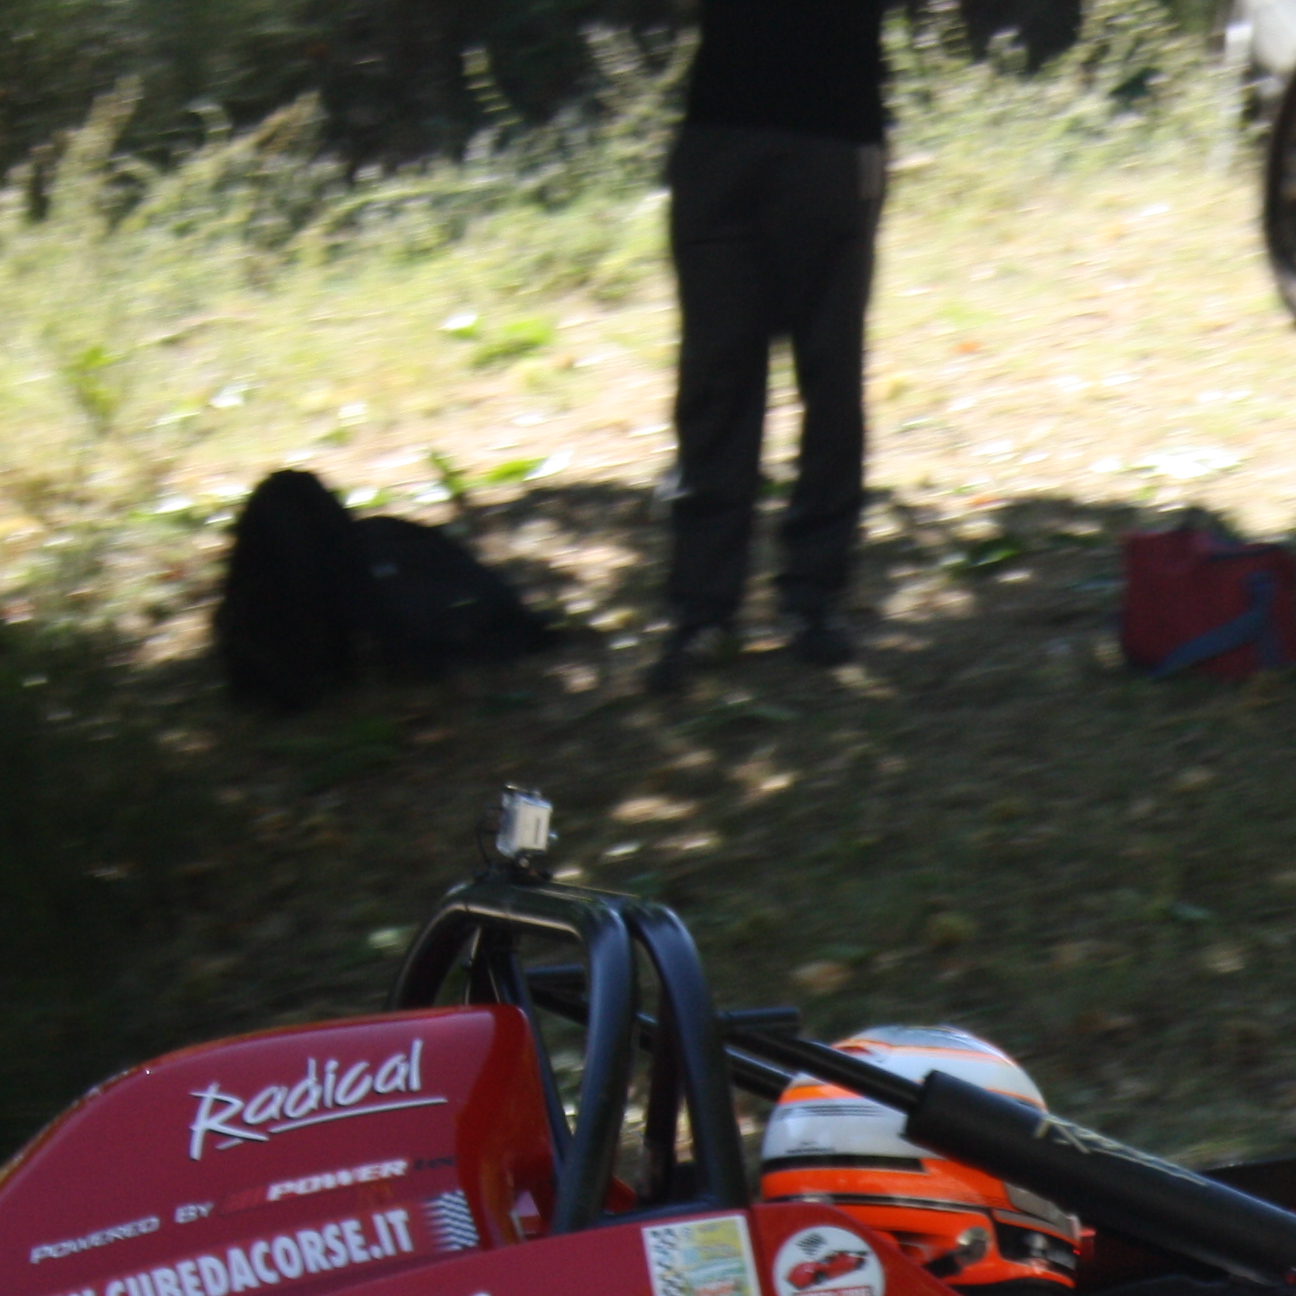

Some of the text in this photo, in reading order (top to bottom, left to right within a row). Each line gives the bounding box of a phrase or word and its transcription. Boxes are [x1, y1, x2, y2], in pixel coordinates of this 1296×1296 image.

[188, 1038, 448, 1161] Radical
[29, 1216, 161, 1264] POWERED
[173, 1203, 214, 1224] BY
